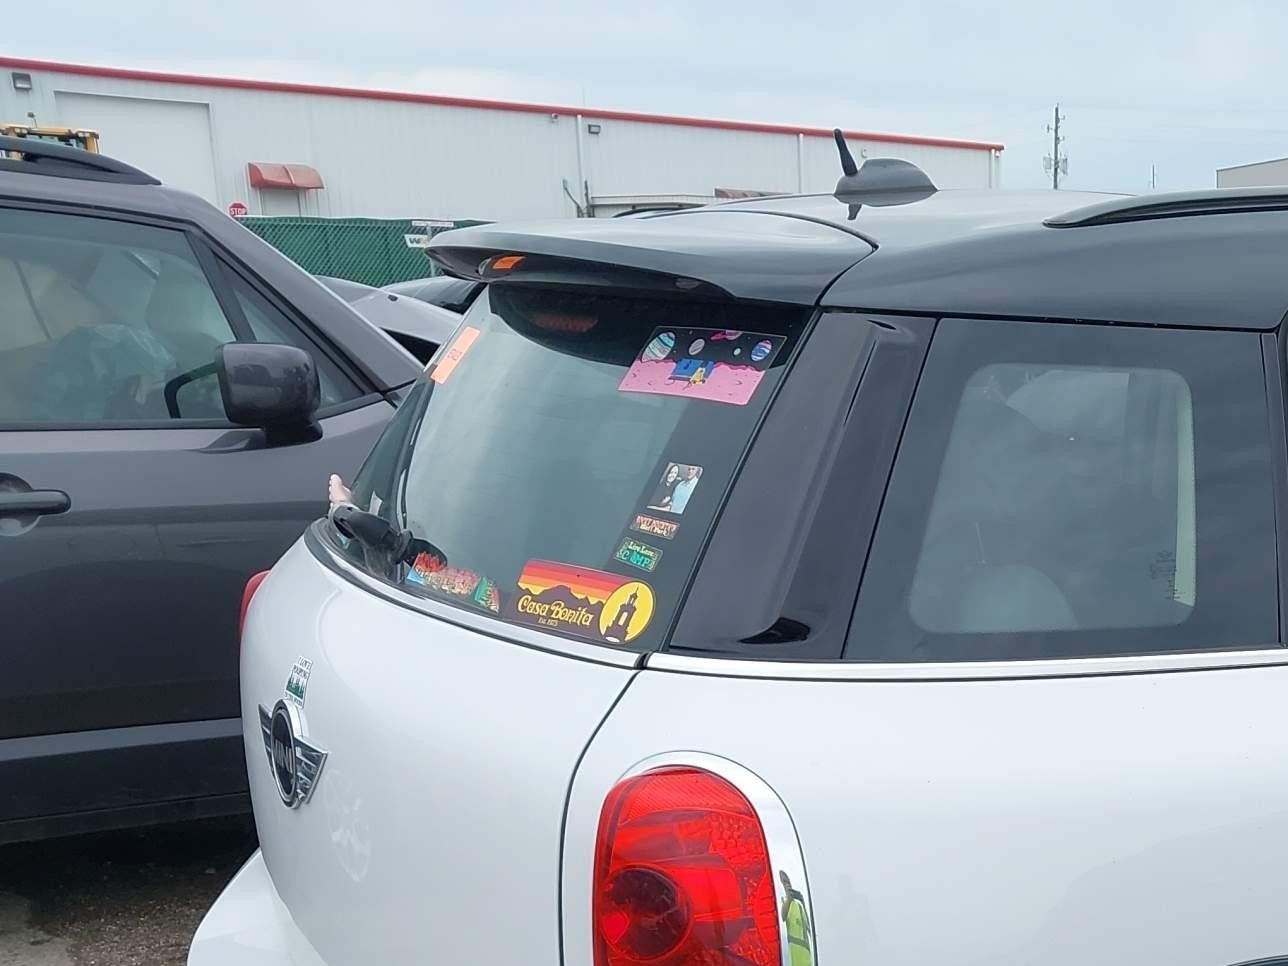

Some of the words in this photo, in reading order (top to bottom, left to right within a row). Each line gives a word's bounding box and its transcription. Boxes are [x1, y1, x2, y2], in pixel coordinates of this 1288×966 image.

[230, 207, 247, 216] STOP
[517, 594, 551, 616] Casa
[550, 600, 595, 626] Bonita
[273, 738, 293, 774] MINI
